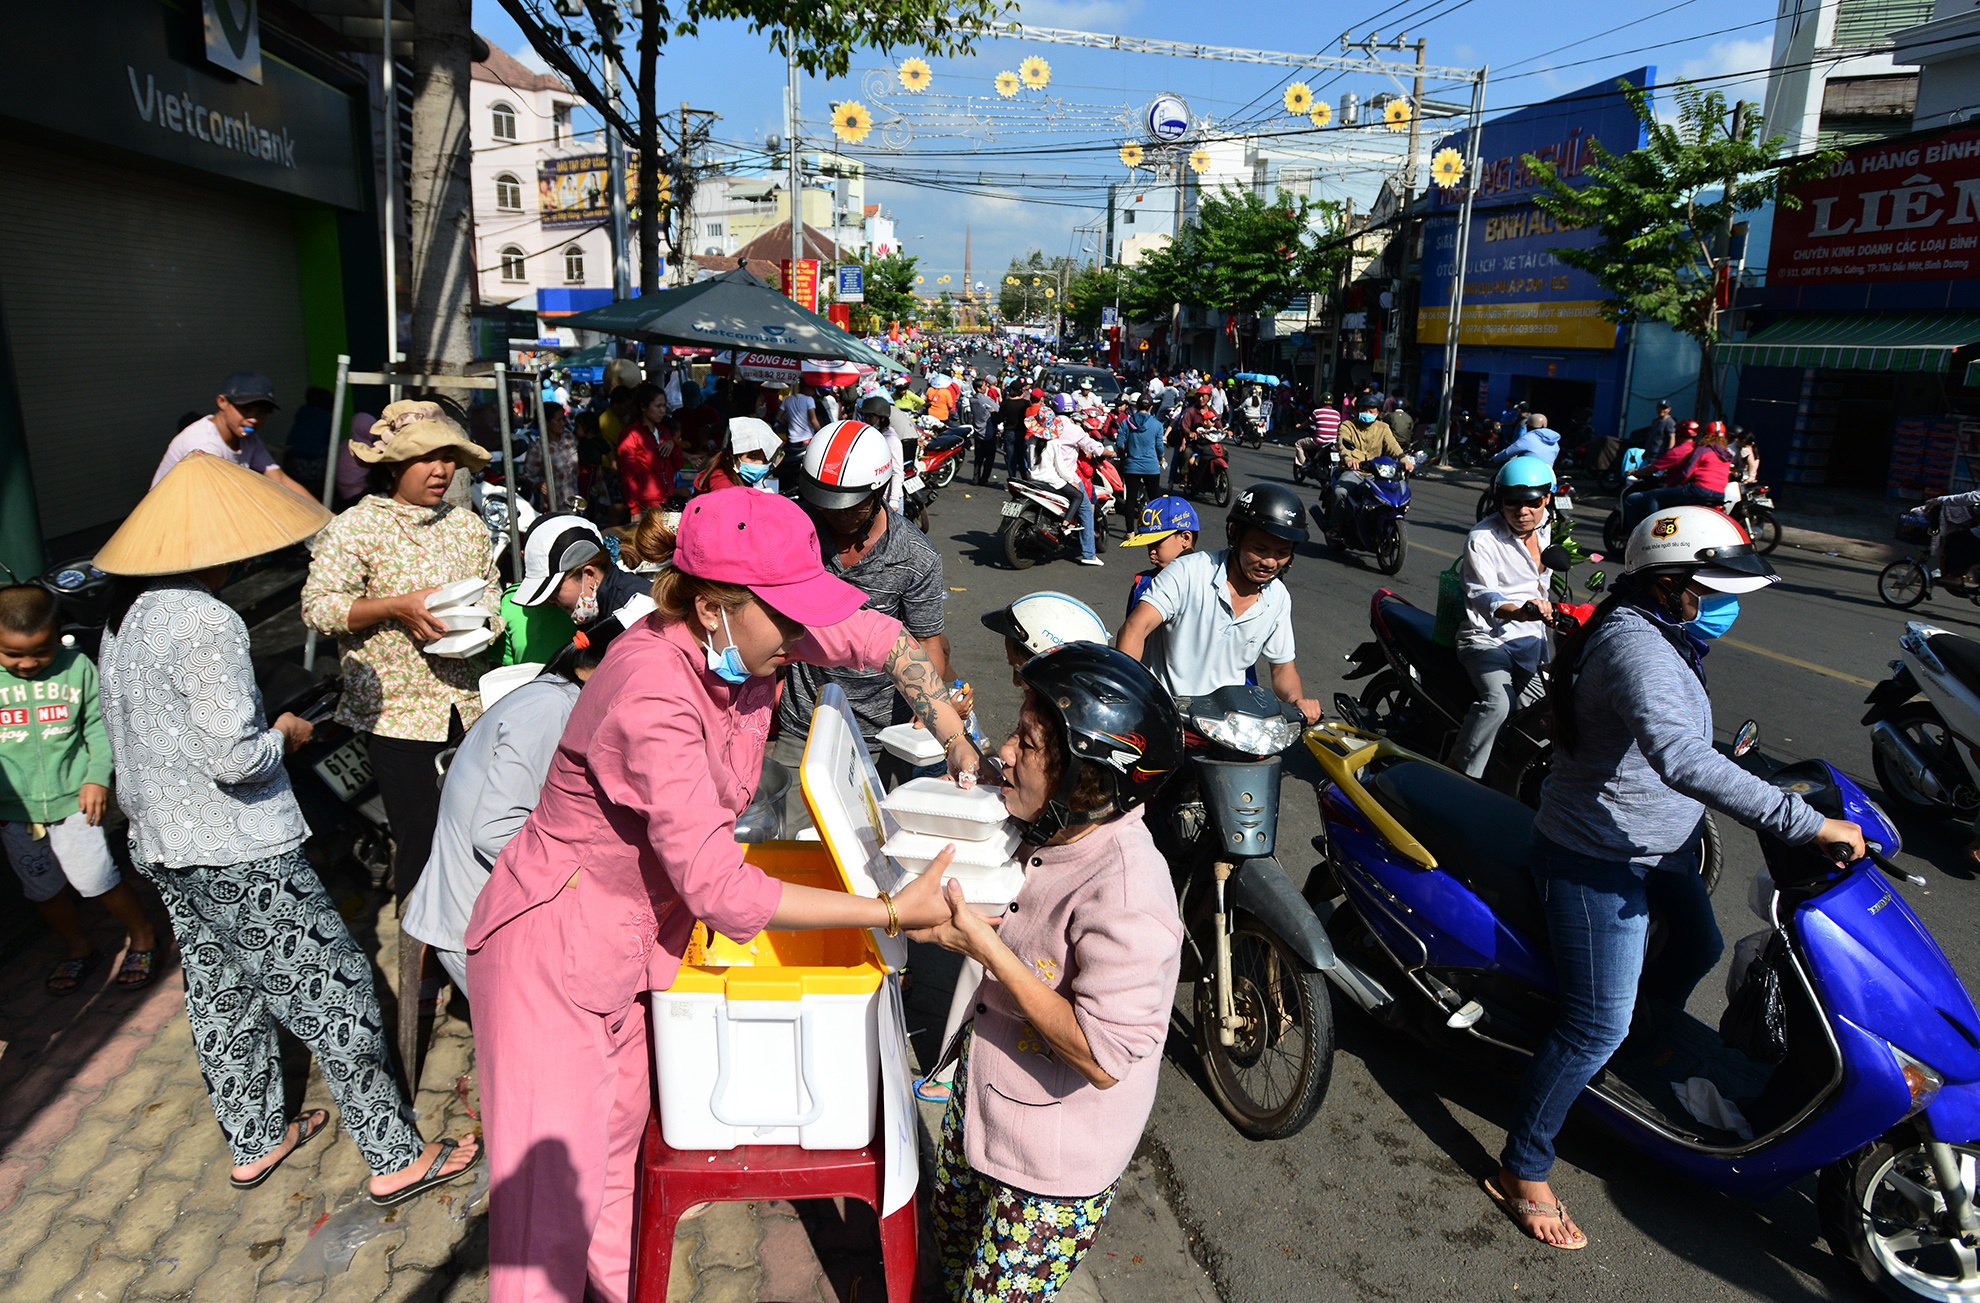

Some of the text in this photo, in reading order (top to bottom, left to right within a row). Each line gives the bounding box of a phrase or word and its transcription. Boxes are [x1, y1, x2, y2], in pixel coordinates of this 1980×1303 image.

[127, 64, 297, 169] Vietcombank
[1860, 149, 1920, 173] HÀNG
[1924, 140, 1980, 164] BÌNH
[1793, 233, 1978, 260] CHUYÊN KINH DOANH CÁC LOẠI BÌNH
[1503, 256, 1516, 270] XE
[691, 324, 798, 344] Vietcombank
[1655, 523, 1675, 535] G8
[38, 705, 69, 721] NIM
[1106, 757, 1127, 774] HONDA
